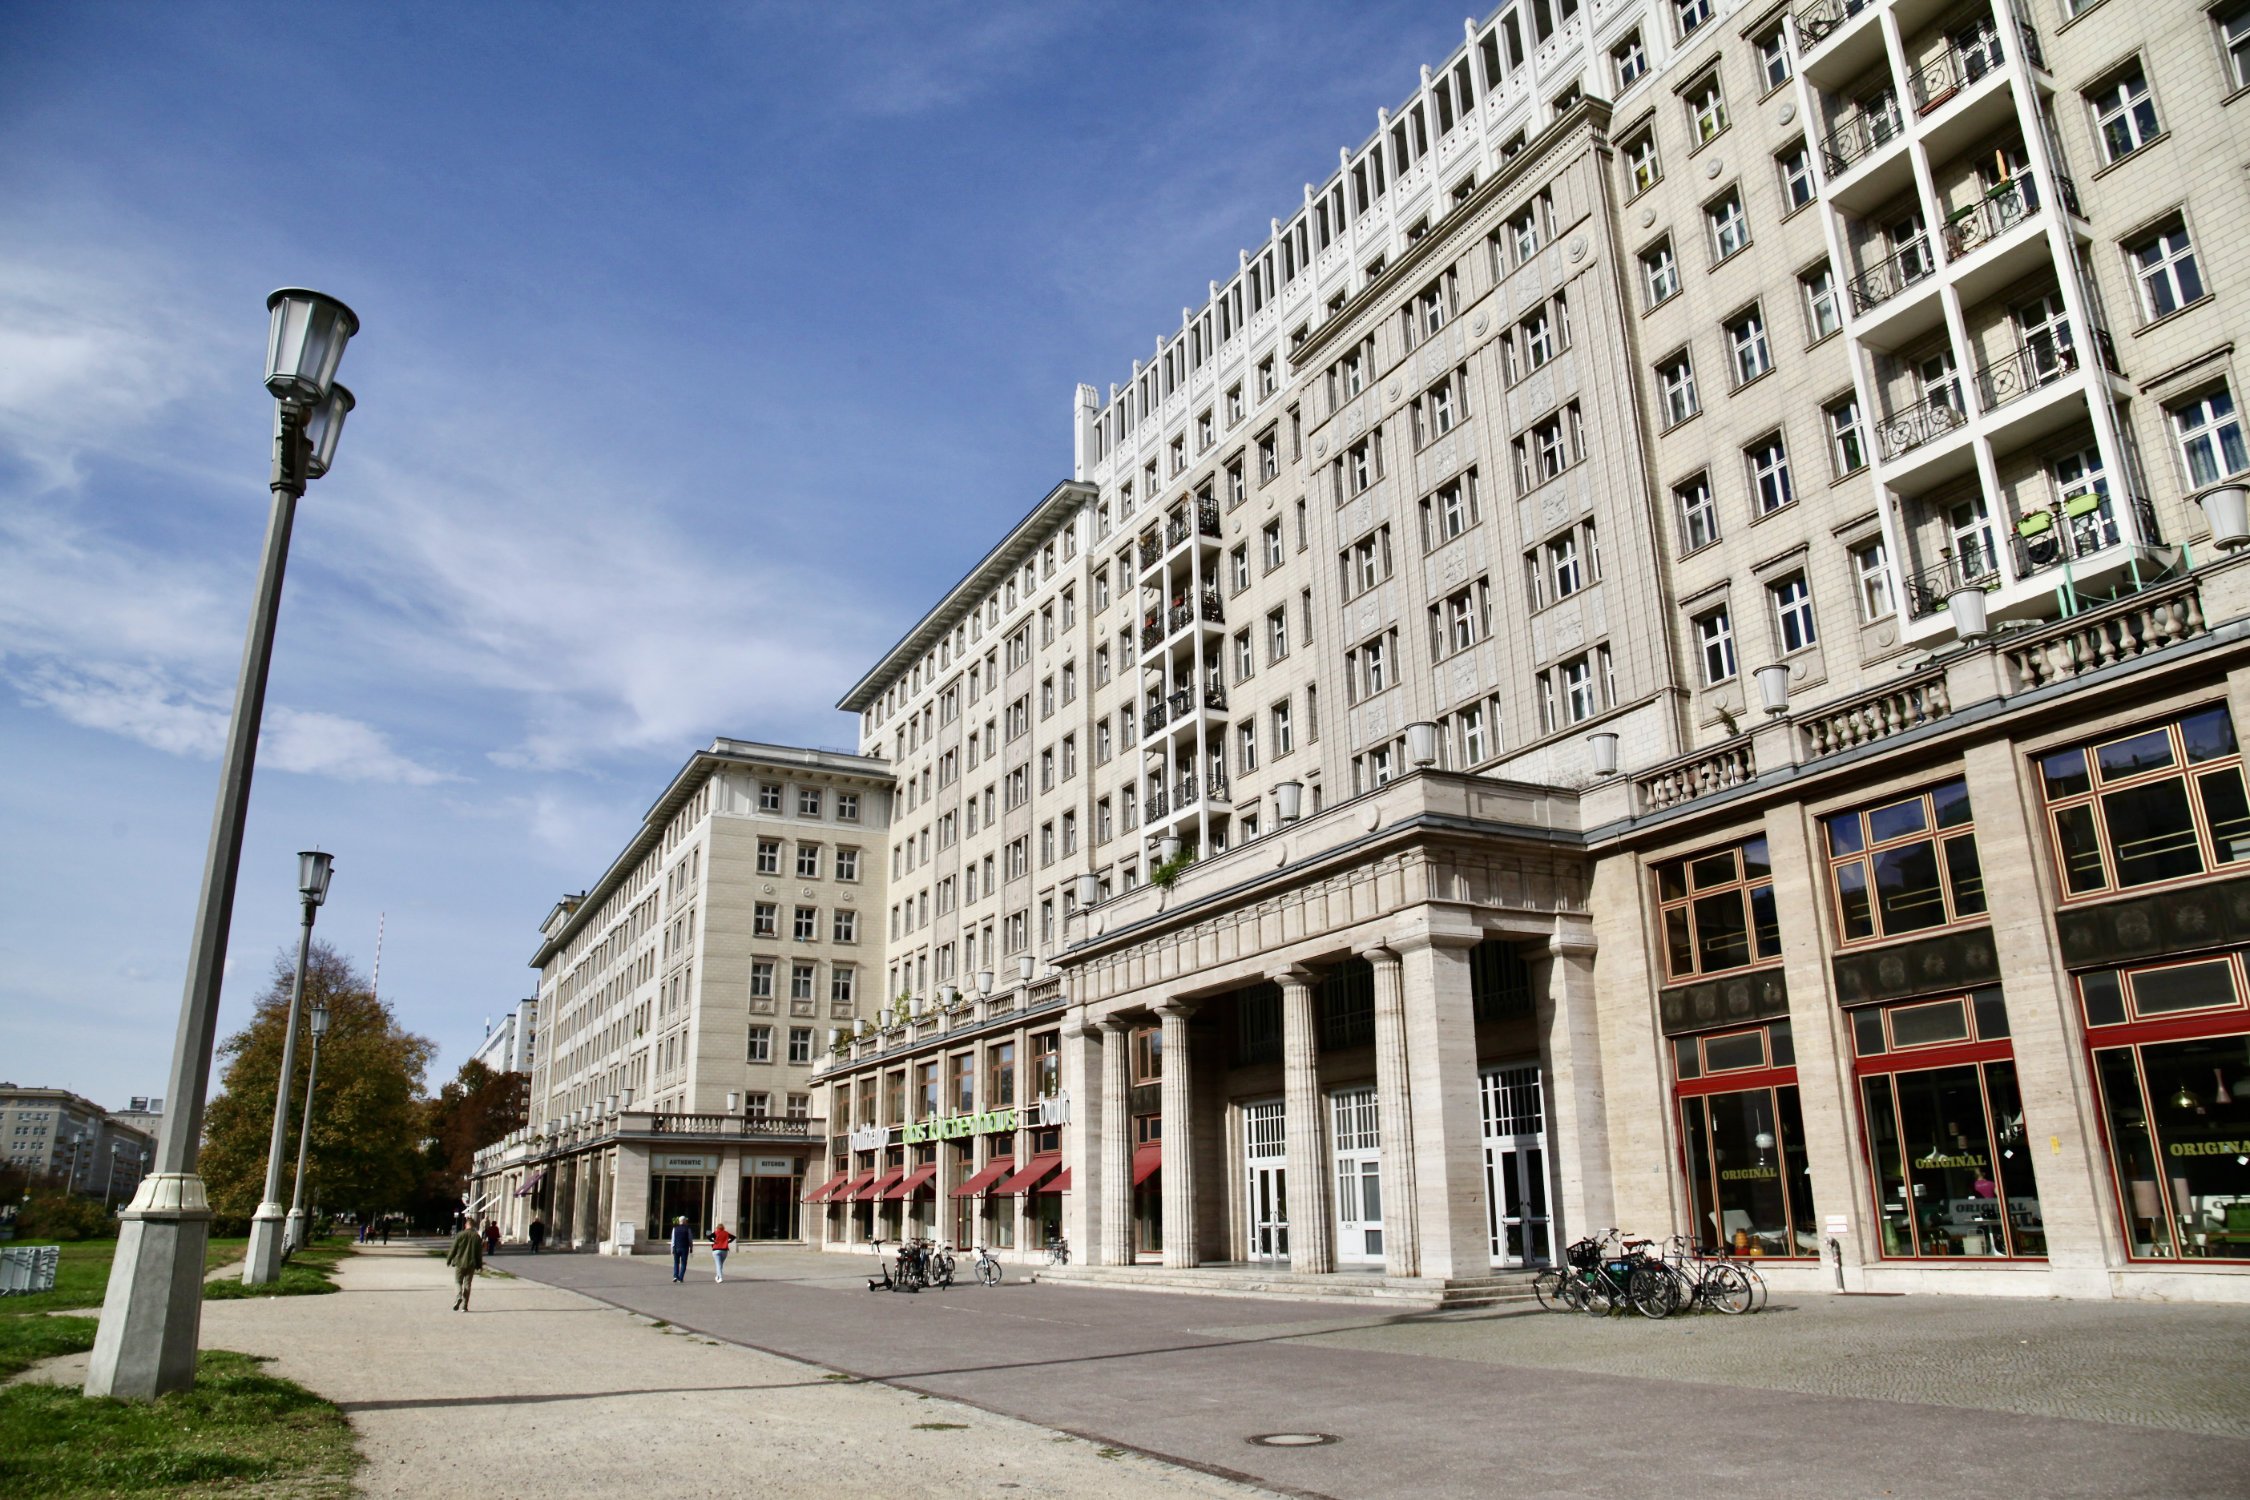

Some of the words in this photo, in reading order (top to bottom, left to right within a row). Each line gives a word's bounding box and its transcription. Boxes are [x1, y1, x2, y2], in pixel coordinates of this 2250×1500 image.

[903, 1114, 926, 1144] das
[1915, 1155, 1987, 1169] ORIGINAL
[1721, 1168, 1777, 1180] ORIGINAL
[1955, 1202, 2027, 1213] ORIGIAL
